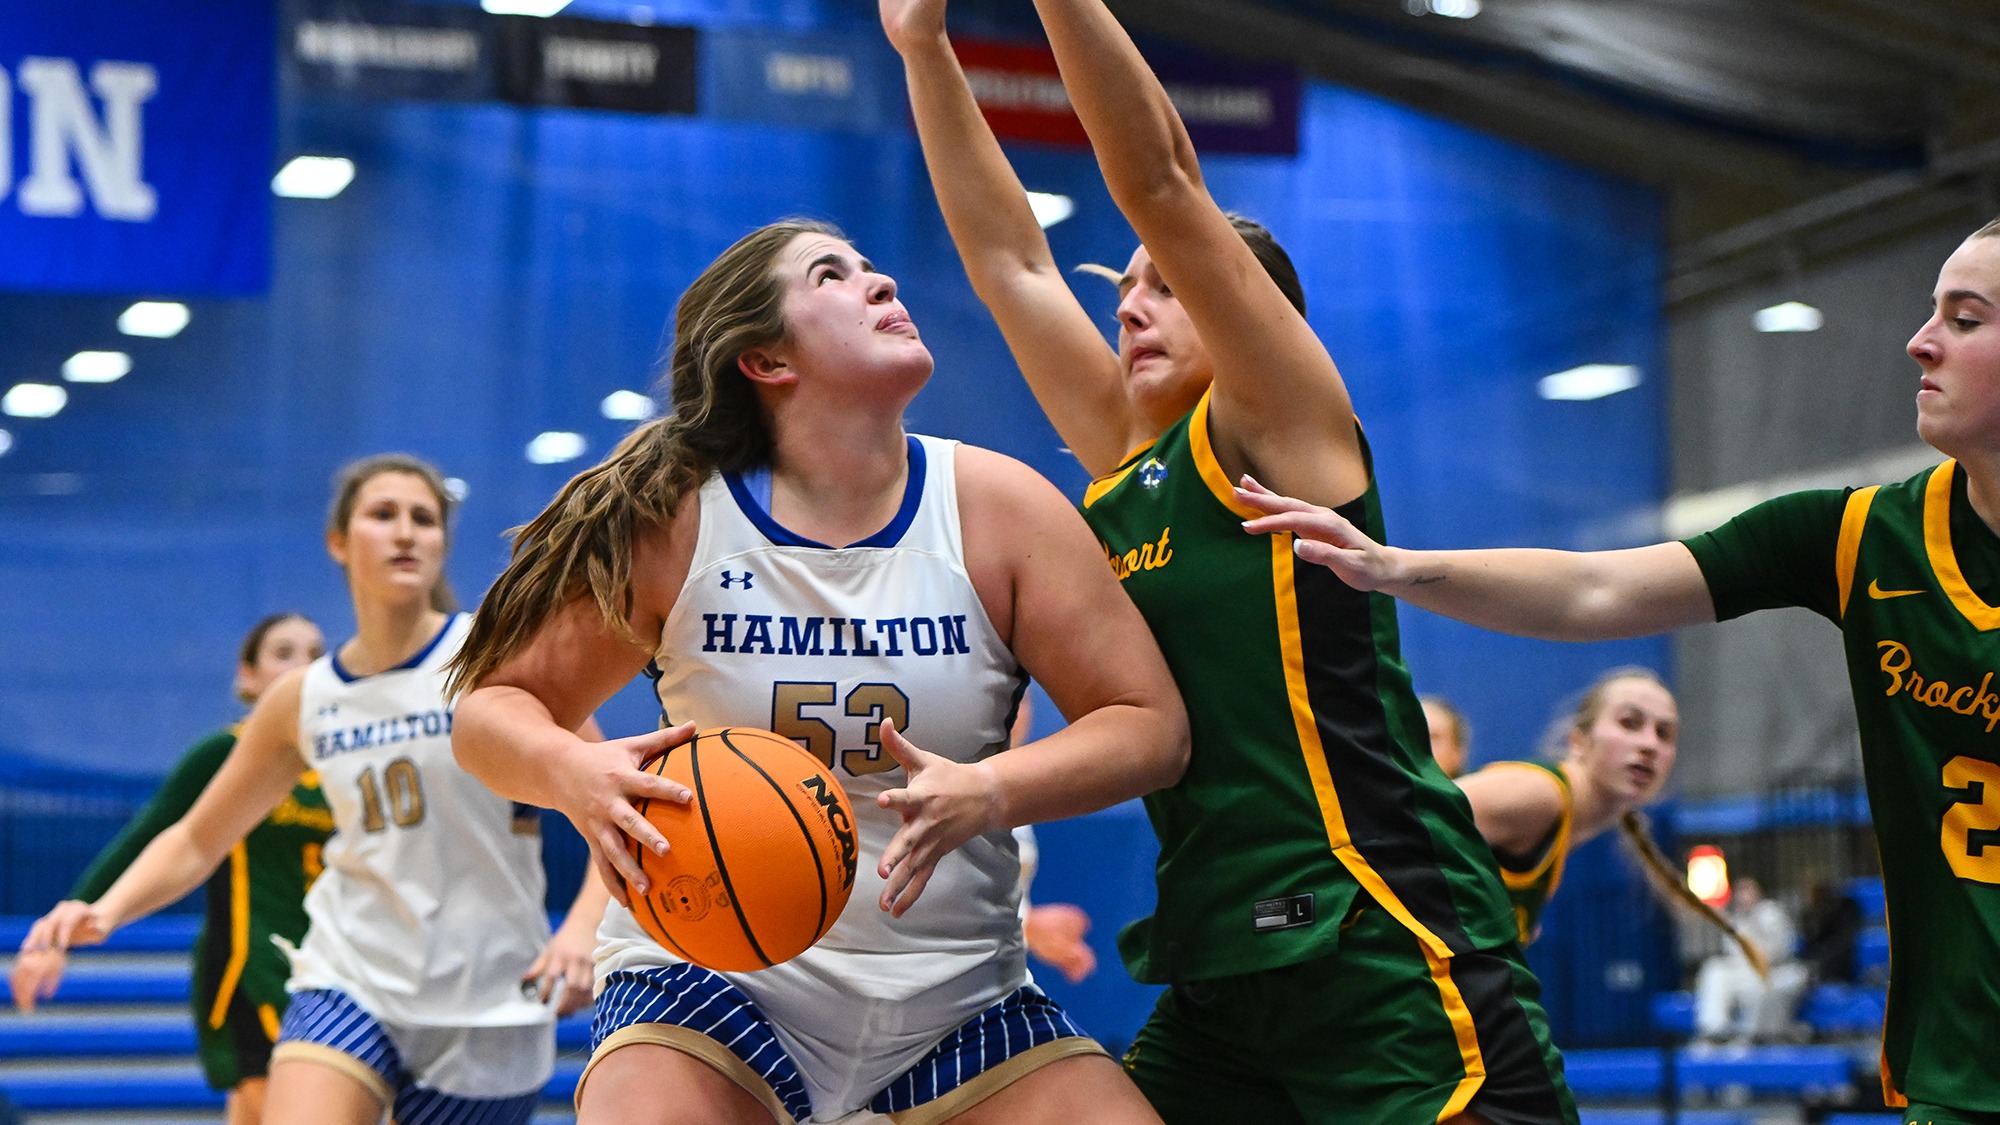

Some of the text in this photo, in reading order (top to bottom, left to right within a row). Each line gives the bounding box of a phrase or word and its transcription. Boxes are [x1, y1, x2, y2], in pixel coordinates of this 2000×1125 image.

[0, 56, 158, 223] N
[702, 613, 970, 656] HAMILTON
[771, 681, 909, 777] 53
[356, 756, 425, 834] 10
[801, 774, 857, 891] NCAA
[1297, 903, 1304, 916] L
